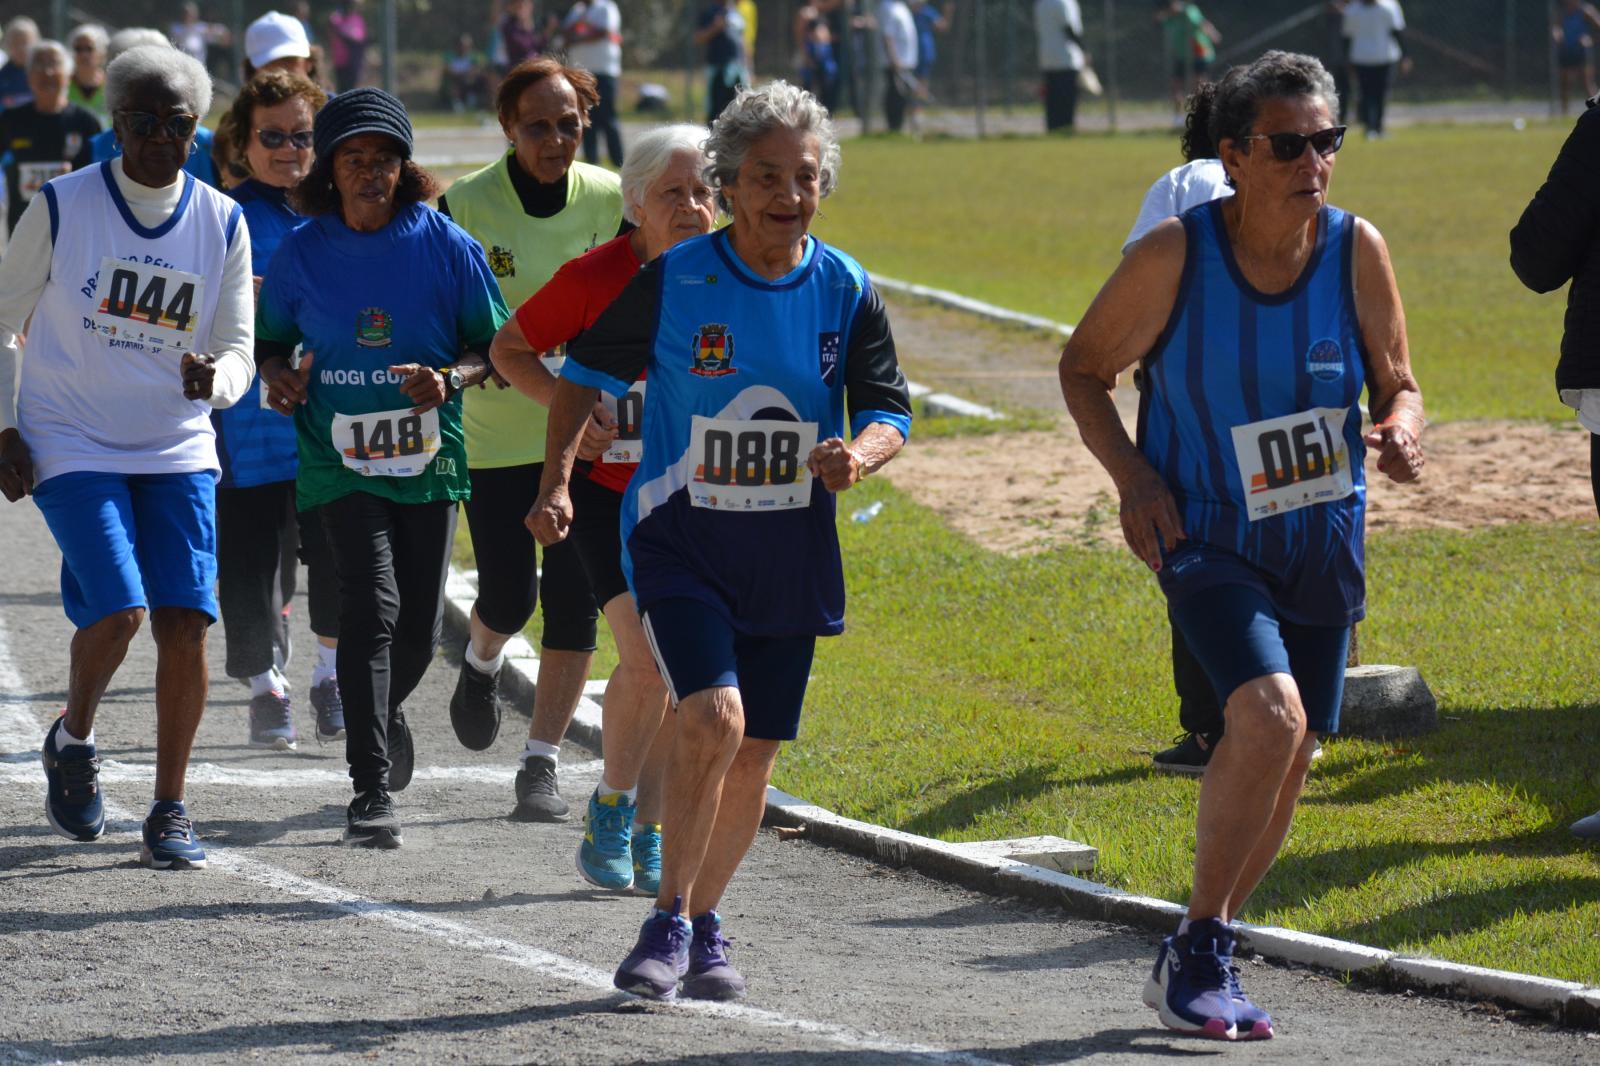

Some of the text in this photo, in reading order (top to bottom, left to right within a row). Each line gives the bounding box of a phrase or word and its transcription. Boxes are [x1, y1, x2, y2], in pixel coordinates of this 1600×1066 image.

[108, 269, 195, 332] 044
[320, 369, 366, 387] MOGI
[350, 415, 424, 461] 148
[704, 428, 800, 487] 088
[1258, 416, 1339, 490] 061
